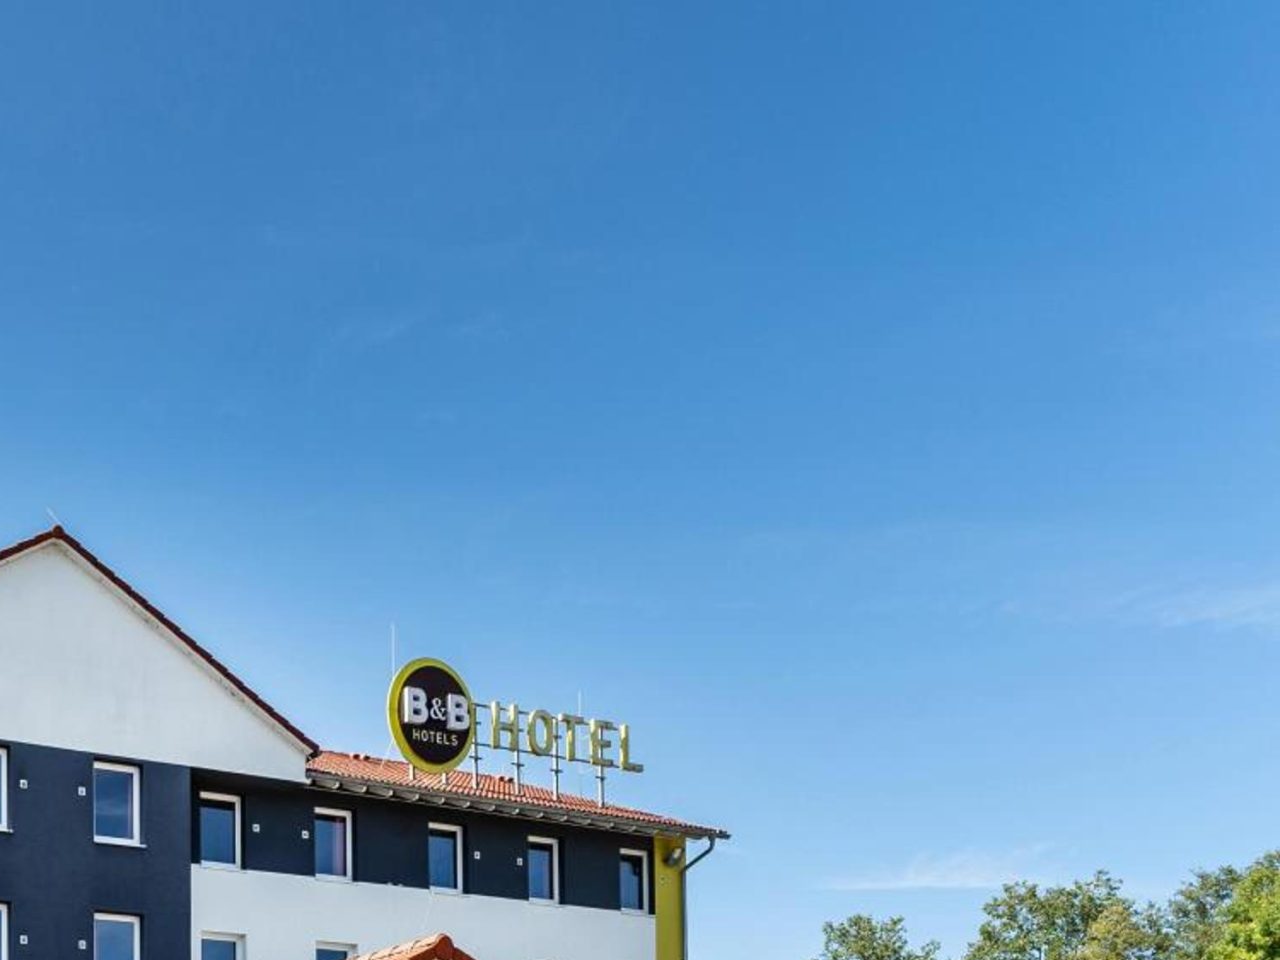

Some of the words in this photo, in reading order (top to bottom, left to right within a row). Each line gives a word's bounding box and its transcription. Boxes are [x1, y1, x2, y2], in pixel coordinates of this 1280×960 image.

[404, 686, 470, 730] B&B
[412, 729, 458, 747] HOTELS
[491, 701, 643, 772] HOTEL
